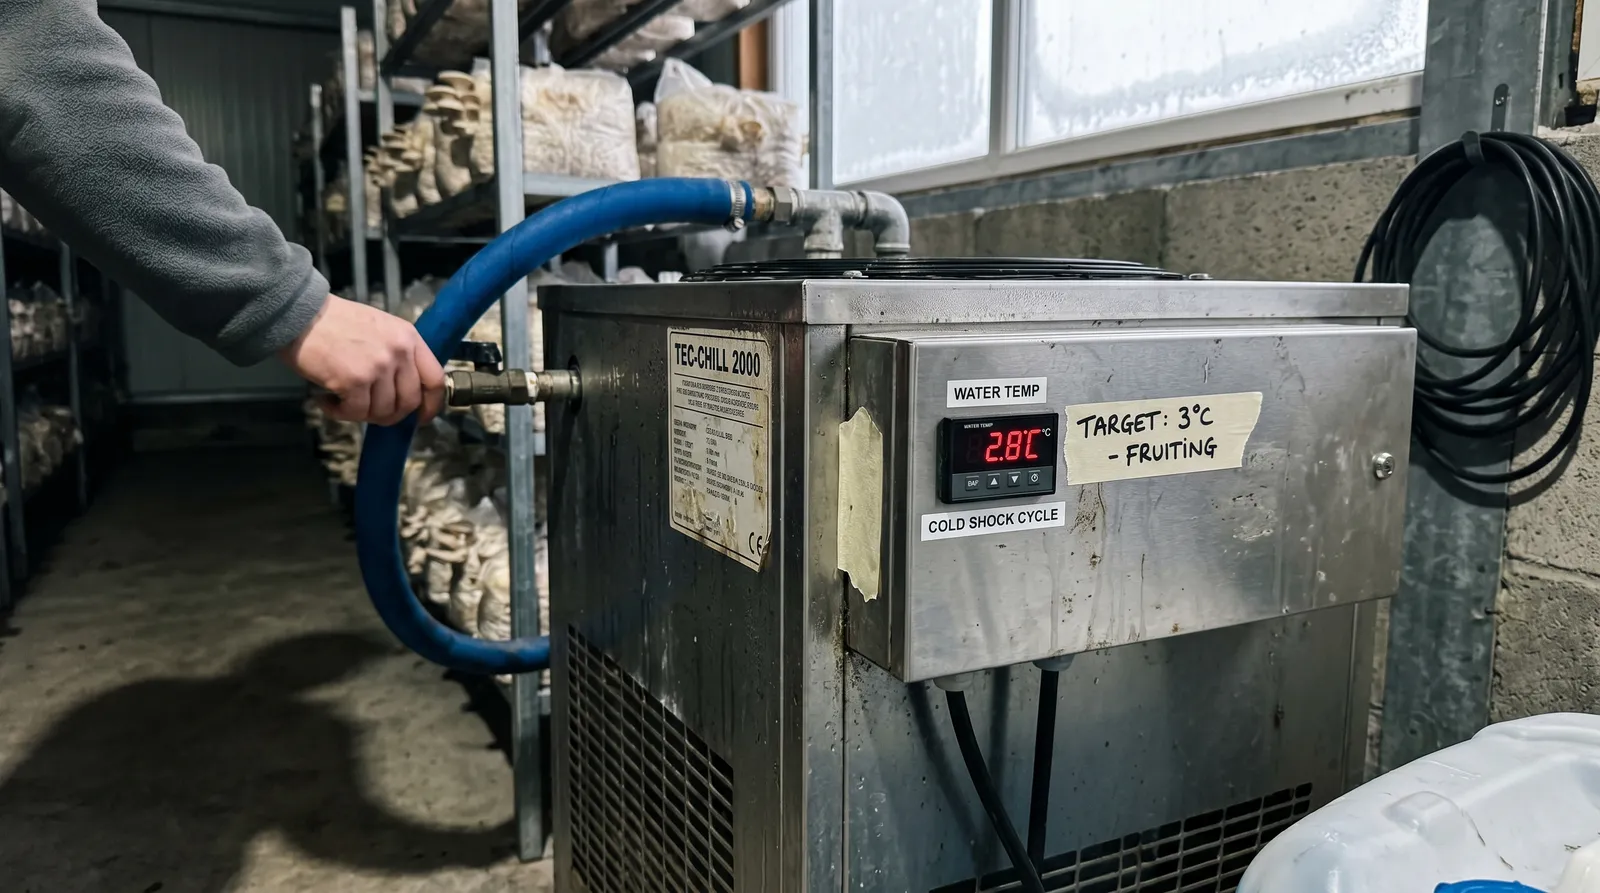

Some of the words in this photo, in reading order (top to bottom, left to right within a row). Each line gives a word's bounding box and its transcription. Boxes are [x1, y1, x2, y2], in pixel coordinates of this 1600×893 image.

[675, 343, 728, 372] TEC-CHILL
[732, 350, 760, 377] 2000
[954, 386, 1001, 400] WATER
[1005, 384, 1040, 397] TEMP
[1077, 410, 1168, 439] TARGET:
[928, 517, 965, 534] COLD
[969, 513, 1015, 529] SHOCK
[1017, 508, 1059, 524] CYCLE
